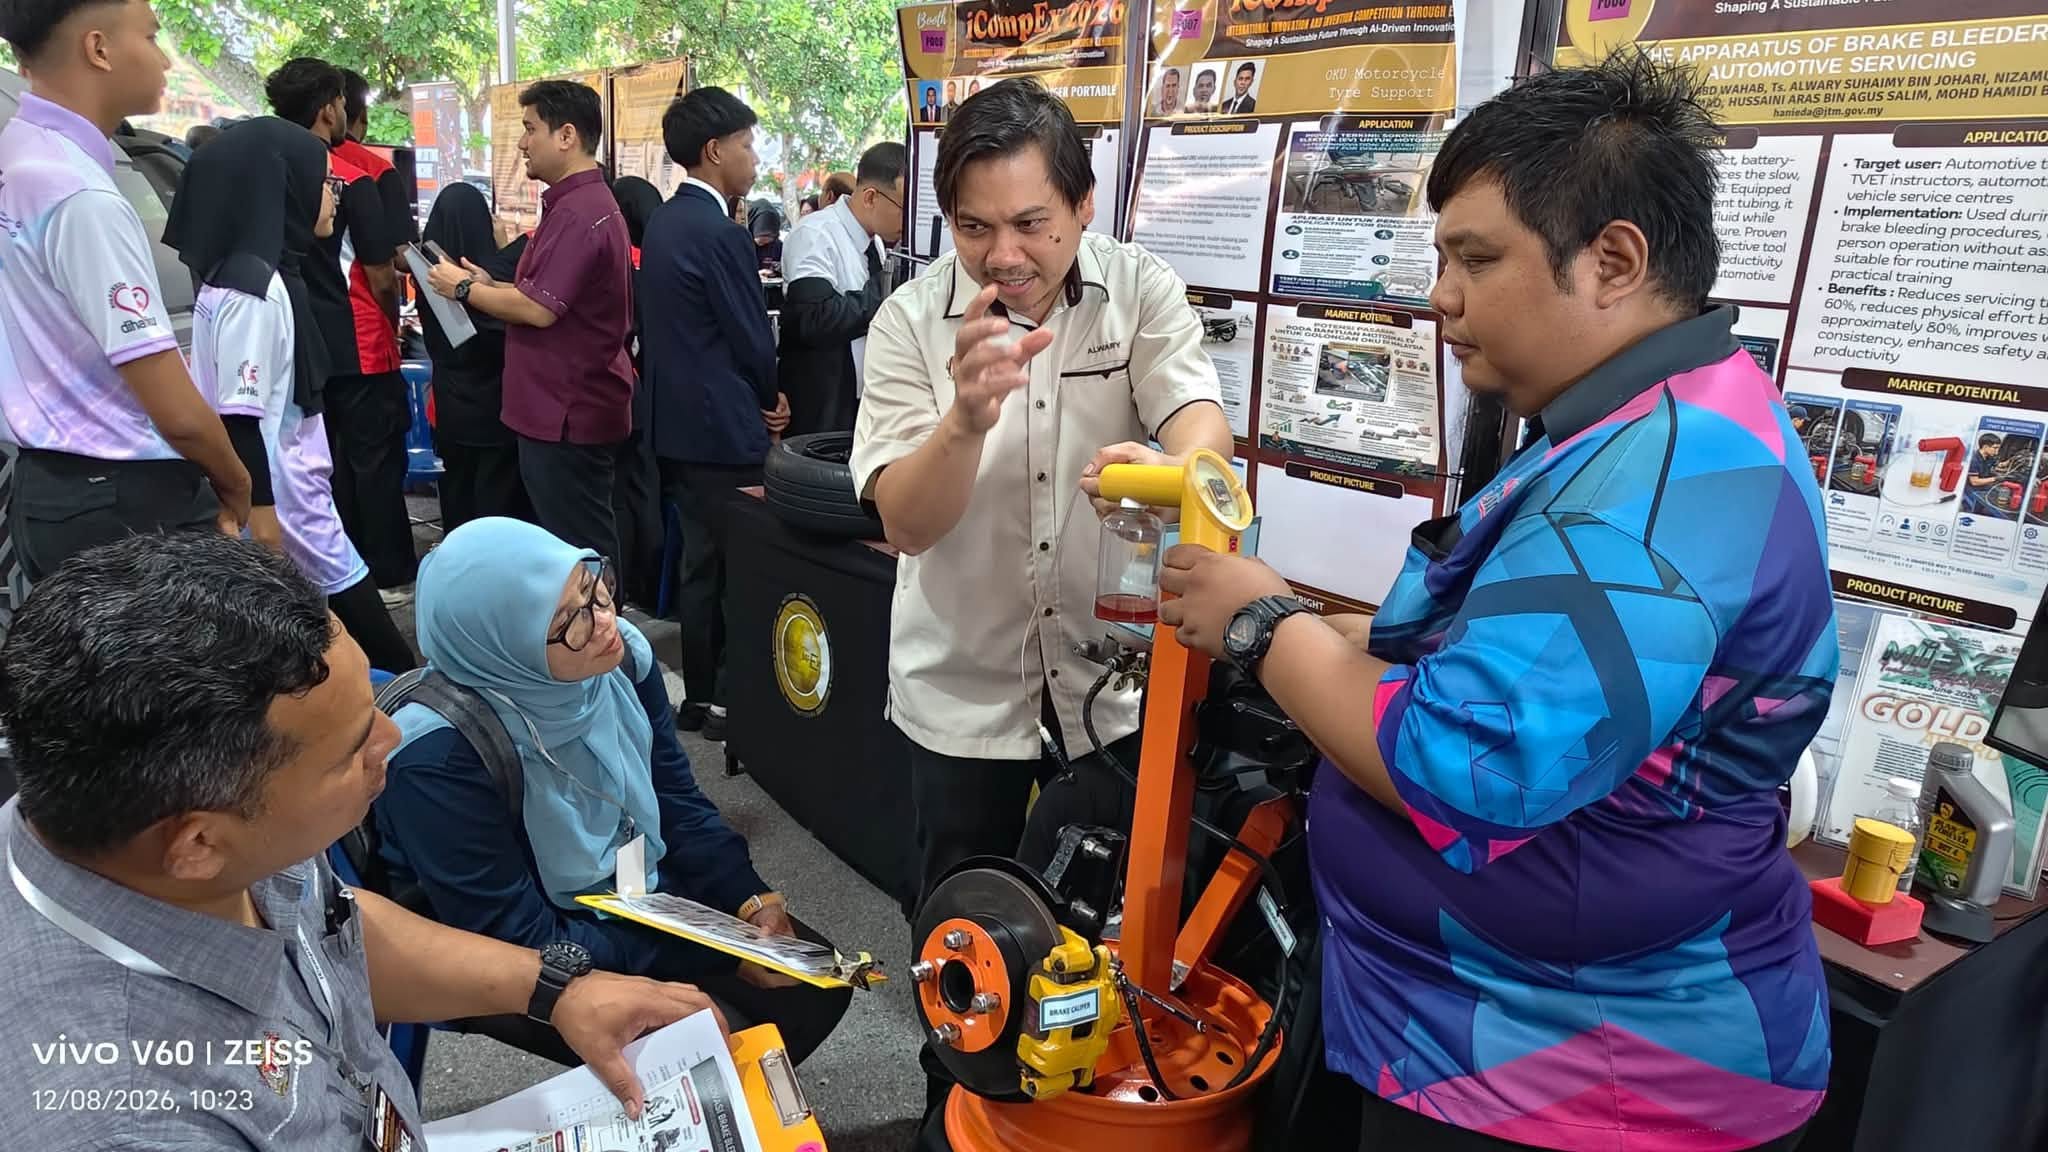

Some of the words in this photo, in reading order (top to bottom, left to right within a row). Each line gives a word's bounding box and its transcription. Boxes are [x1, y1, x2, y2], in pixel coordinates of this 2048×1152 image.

[1715, 1, 1767, 14] Shaping
[1770, 0, 1781, 10] A
[917, 6, 946, 28] Booth
[1271, 19, 1310, 33] INNOVATION
[1354, 8, 1403, 24] COMPETITION
[1406, 5, 1447, 18] THROUGH
[1245, 37, 1273, 48] Shaping
[1280, 32, 1318, 45] Sustainable
[1318, 29, 1339, 40] Future
[1339, 25, 1369, 38] Through
[1369, 22, 1411, 34] AI-Driven
[1679, 38, 1801, 62] APPARATUS
[1807, 36, 1838, 54] OF
[1843, 31, 1924, 52] BRAKE
[1931, 23, 2048, 48] BLEEDER
[1709, 57, 1843, 80] AUTOMOTIVE
[1849, 51, 1977, 73] SERVICING
[1325, 68, 1347, 81] OKU
[1354, 66, 1446, 84] Motorcycle
[1072, 85, 1117, 97] PORTABLE
[1720, 83, 1767, 96] WAHAB,
[1772, 82, 1786, 92] Ts.
[1789, 79, 1842, 92] ALWARY
[1844, 77, 1905, 90] SUHAIMY
[1907, 76, 1931, 87] BIN
[1934, 73, 1990, 87] JOHARI,
[1328, 88, 1361, 101] Tyre
[1370, 86, 1434, 101] Support
[1728, 95, 1785, 107] HUSSAINI
[1787, 94, 1820, 105] ARAS
[1823, 92, 1845, 103] BIN
[1848, 91, 1883, 103] AGUS
[1887, 89, 1932, 101] SALIM,
[1936, 87, 1979, 100] MOHD
[1982, 86, 2037, 98] HAMIDI
[1773, 106, 1883, 119] hanieda@jtm.gov.my
[1358, 119, 1414, 129] APPLICATION
[1741, 155, 1796, 168] battery-
[1853, 158, 1901, 173] Target
[1904, 159, 1942, 170] user:
[1945, 157, 2037, 171] Automotive
[1744, 169, 1766, 180] the
[1768, 170, 1800, 182] slow,
[1851, 174, 1888, 185] TVET
[1890, 174, 1974, 188] instructors,
[1731, 183, 1792, 197] Equipped
[1847, 190, 1896, 202] vehicle
[1900, 191, 1952, 203] service
[1955, 192, 2014, 204] centres
[1713, 199, 1735, 209] ent
[1737, 198, 1781, 212] tubing,
[1784, 199, 1793, 209] it
[1712, 212, 1740, 223] fluid
[1743, 212, 1775, 223] while
[1843, 206, 1963, 222] Implementation:
[1966, 208, 2007, 221] Used
[1714, 227, 1742, 237] sure.
[1745, 226, 1787, 238] Proven
[1841, 221, 1880, 233] brake
[1884, 222, 1947, 238] bleeding
[1950, 224, 2042, 241] procedures,
[1763, 241, 1787, 253] tool
[1837, 238, 1885, 252] person
[1889, 239, 1959, 254] operation
[1963, 241, 2025, 256] without
[1719, 254, 1783, 270] roductivity
[1834, 252, 1890, 266] suitable
[1892, 253, 1914, 268] for
[1915, 257, 1969, 270] routine
[1972, 259, 2048, 274] maintena
[1718, 269, 1776, 282] utomotive
[1830, 268, 1892, 283] practical
[1896, 272, 1953, 289] training
[1828, 283, 1887, 297] Benefits
[1897, 287, 1960, 303] Reduces
[1964, 292, 2036, 311] servicing
[1324, 309, 1359, 321] MARKET
[1360, 313, 1394, 324] POTENTIAL
[1824, 298, 1857, 313] 60%,
[1860, 300, 1919, 315] reduces
[1921, 304, 1984, 321] physical
[1988, 310, 2035, 325] effort
[1821, 313, 1923, 335] approximately
[1926, 321, 1962, 338] 80%,
[1965, 324, 2038, 342] improves
[1087, 340, 1121, 354] ALWARY
[1817, 329, 1903, 349] consistency,
[1907, 337, 1980, 354] enhances
[1983, 343, 2034, 361] safety
[1813, 344, 1901, 365] productivity
[1887, 376, 1944, 396] MARKET
[1945, 382, 2021, 403] POTENTIAL
[1310, 470, 1342, 484] PRODUCT
[1343, 477, 1375, 490] PICTURE
[1847, 578, 1907, 602] PRODUCT
[1908, 590, 1965, 614] PICTURE
[1863, 693, 1990, 743] GOLD
[1049, 1007, 1070, 1017] BRAKE
